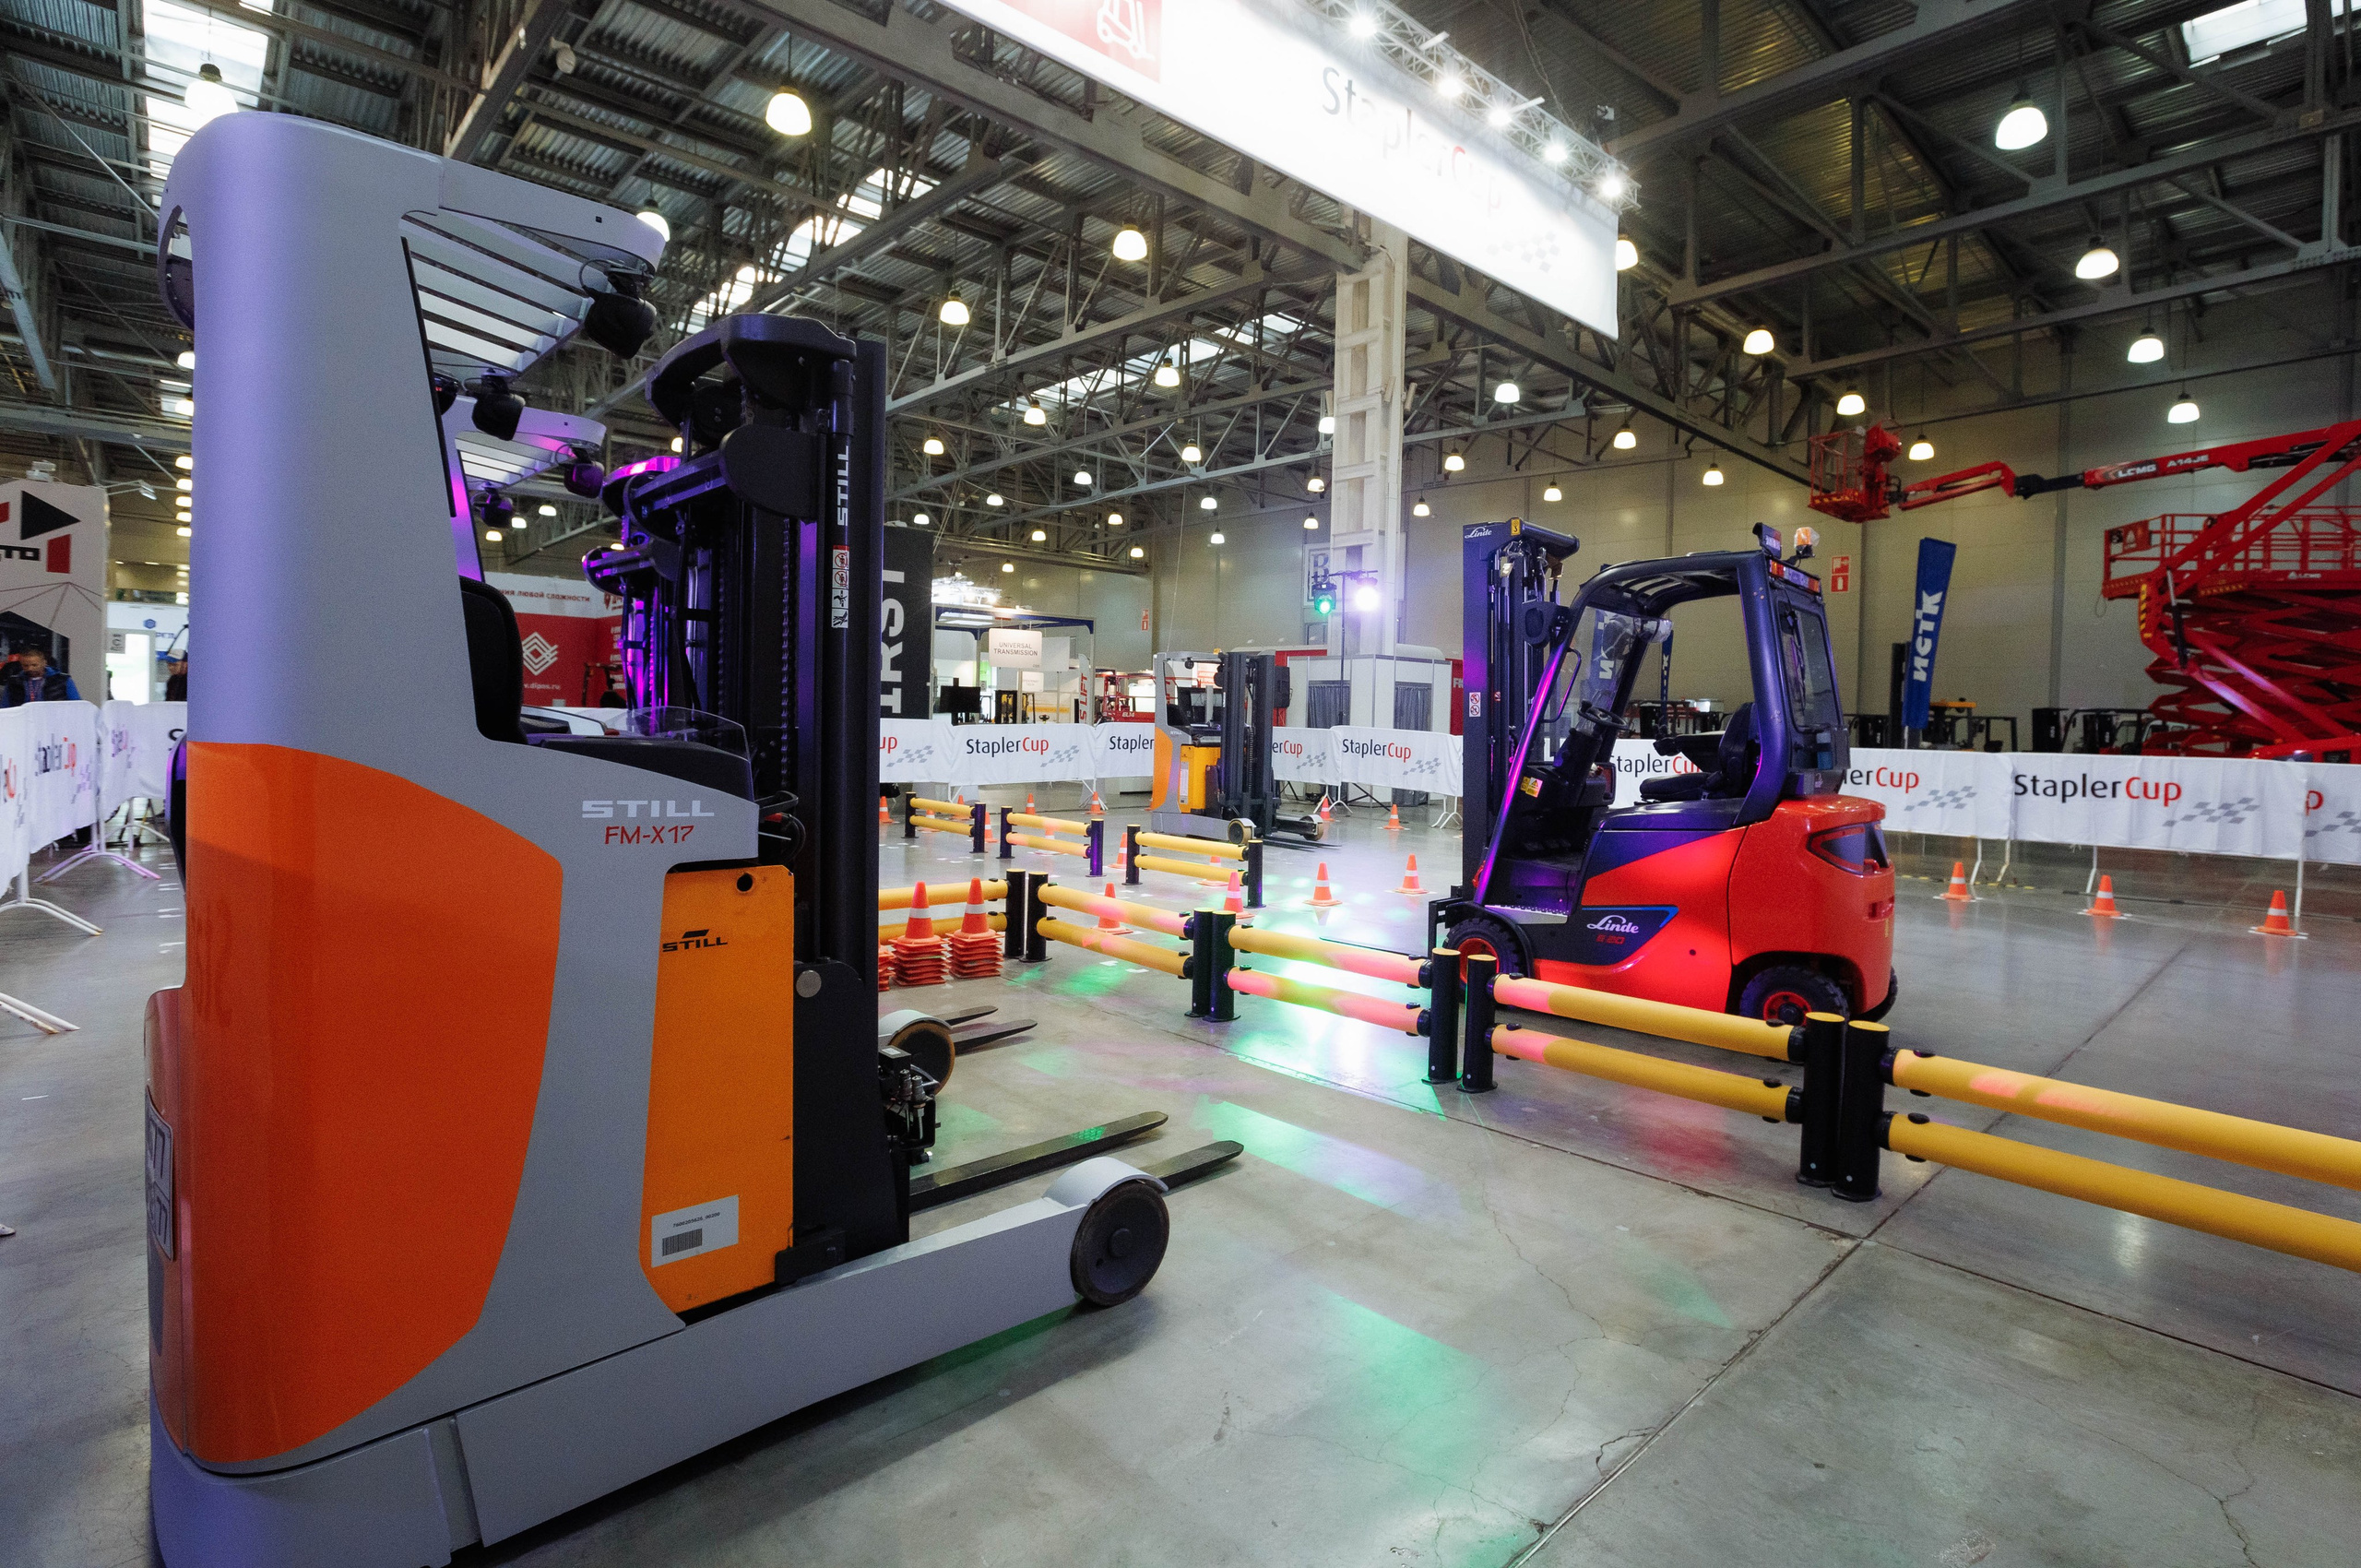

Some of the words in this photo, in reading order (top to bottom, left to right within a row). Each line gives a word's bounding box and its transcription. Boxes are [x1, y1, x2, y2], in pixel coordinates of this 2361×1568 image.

[1322, 66, 1501, 216] StaplerCp
[837, 445, 849, 527] STILL
[1465, 527, 1492, 539] Linde
[546, 592, 590, 602] СЛОЖНОСТИ
[1080, 672, 1088, 707] LIFT
[966, 736, 1050, 757] StaplerCup
[1342, 739, 1412, 763] StaplerCup
[1609, 754, 1702, 778] taplerCu
[2014, 772, 2182, 807] StaplerCup
[582, 800, 715, 818] STILL
[1586, 914, 1639, 933] Linde
[662, 936, 728, 953] STILL
